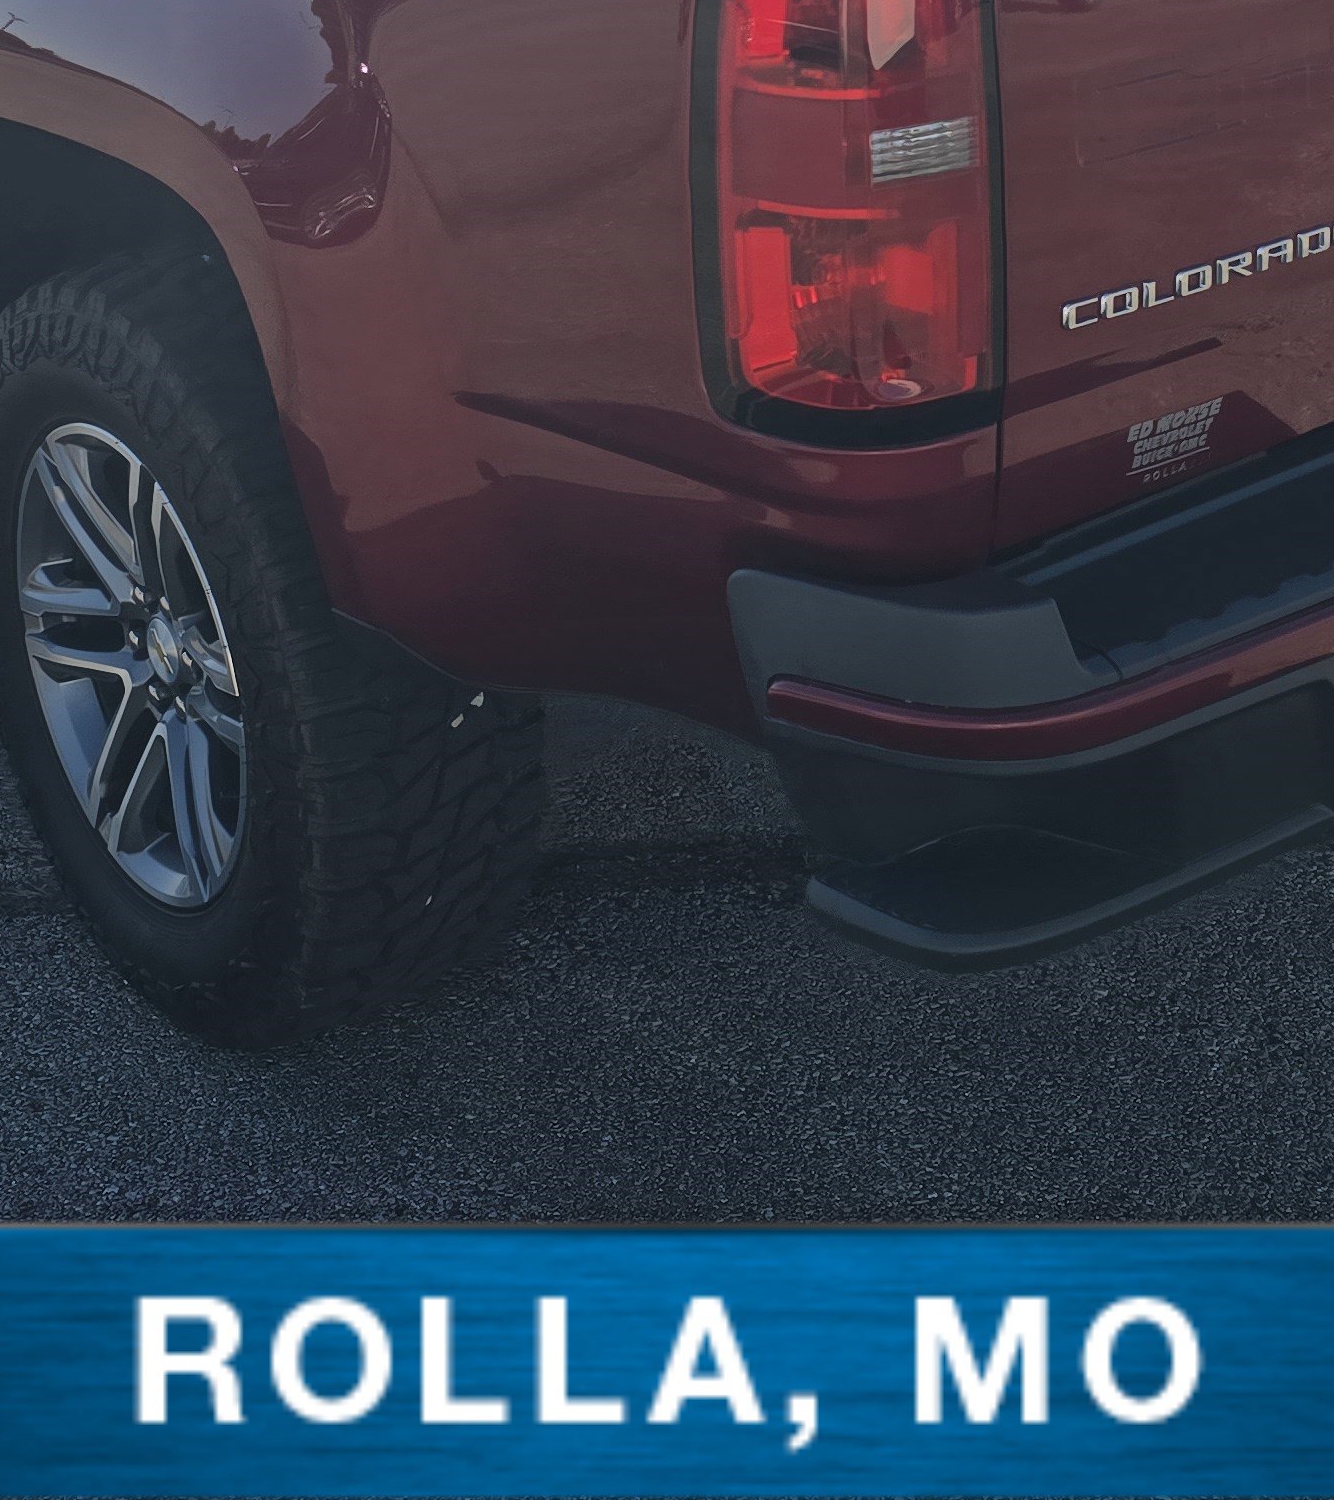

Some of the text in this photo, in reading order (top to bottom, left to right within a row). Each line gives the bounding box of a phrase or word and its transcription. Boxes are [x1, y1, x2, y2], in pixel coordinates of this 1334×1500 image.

[1126, 396, 1224, 443] ED MORSE
[1133, 417, 1214, 455] CHEVROLET
